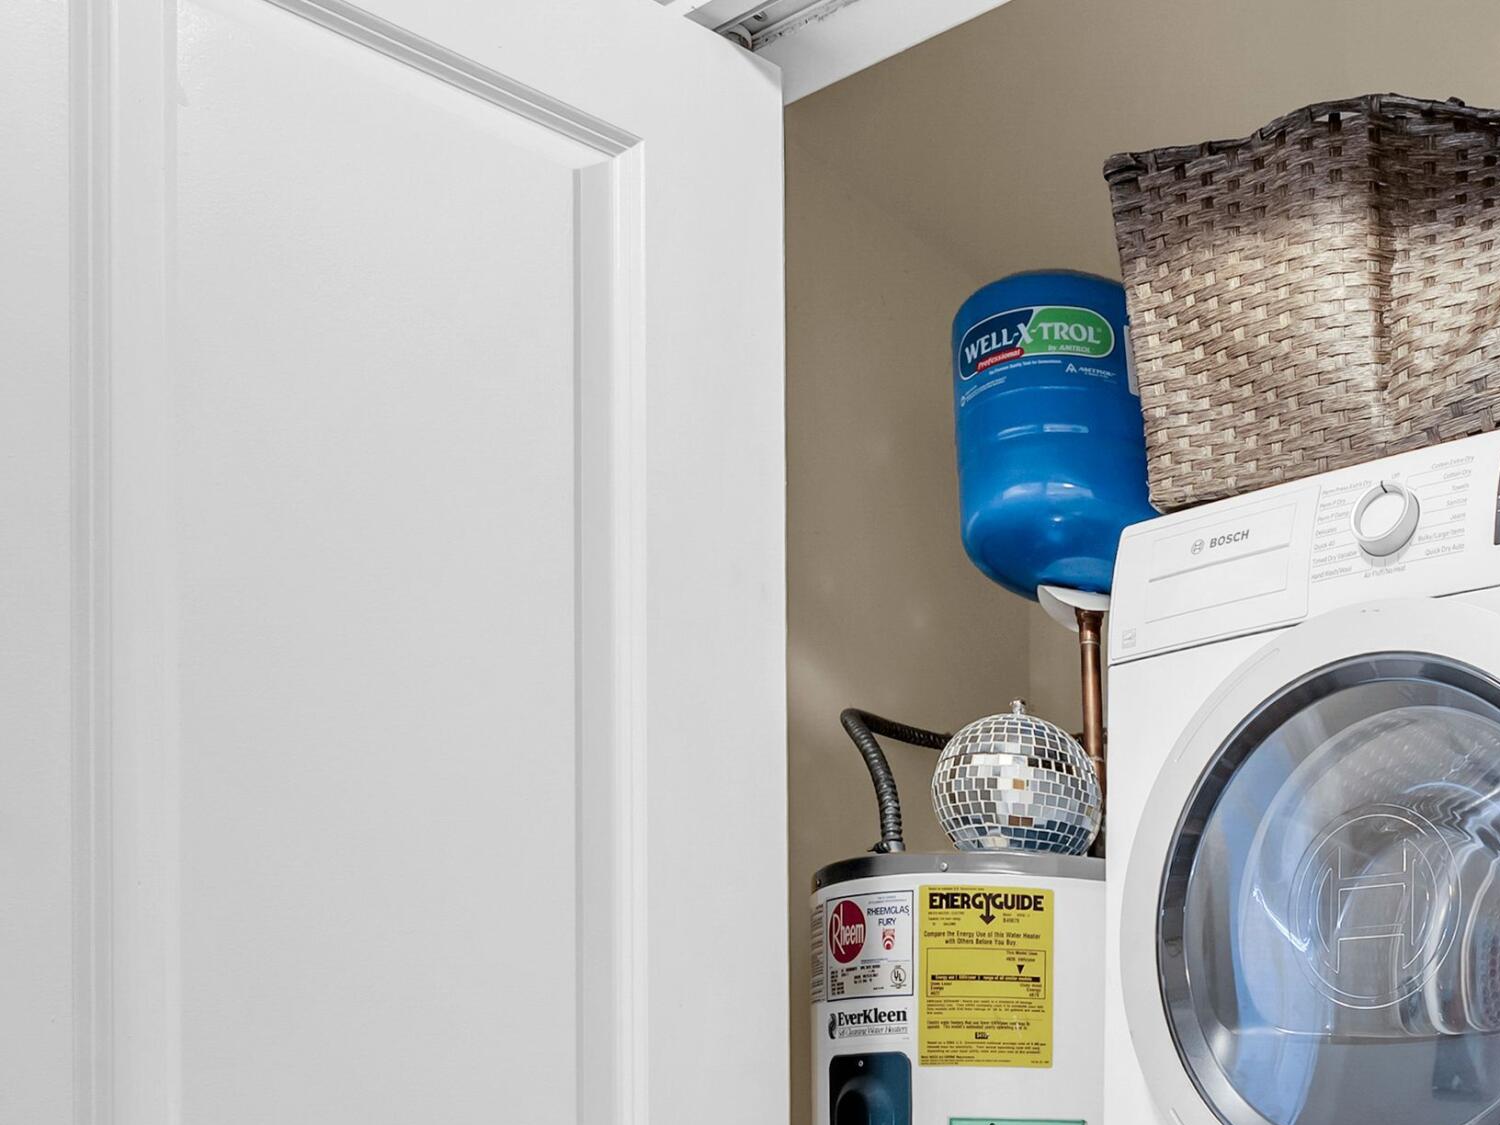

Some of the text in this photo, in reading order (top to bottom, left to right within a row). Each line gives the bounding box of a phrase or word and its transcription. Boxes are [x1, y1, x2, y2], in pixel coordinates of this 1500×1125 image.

[977, 349, 1021, 370] Professional
[1210, 529, 1249, 548] BOSCH
[867, 905, 909, 916] RHEEMGLAS
[929, 892, 1044, 911] ENERGYGUIDE
[832, 904, 864, 955] Rheem
[878, 918, 896, 926] FURY
[924, 930, 945, 938] Compare
[838, 1008, 907, 1026] EverKleen
